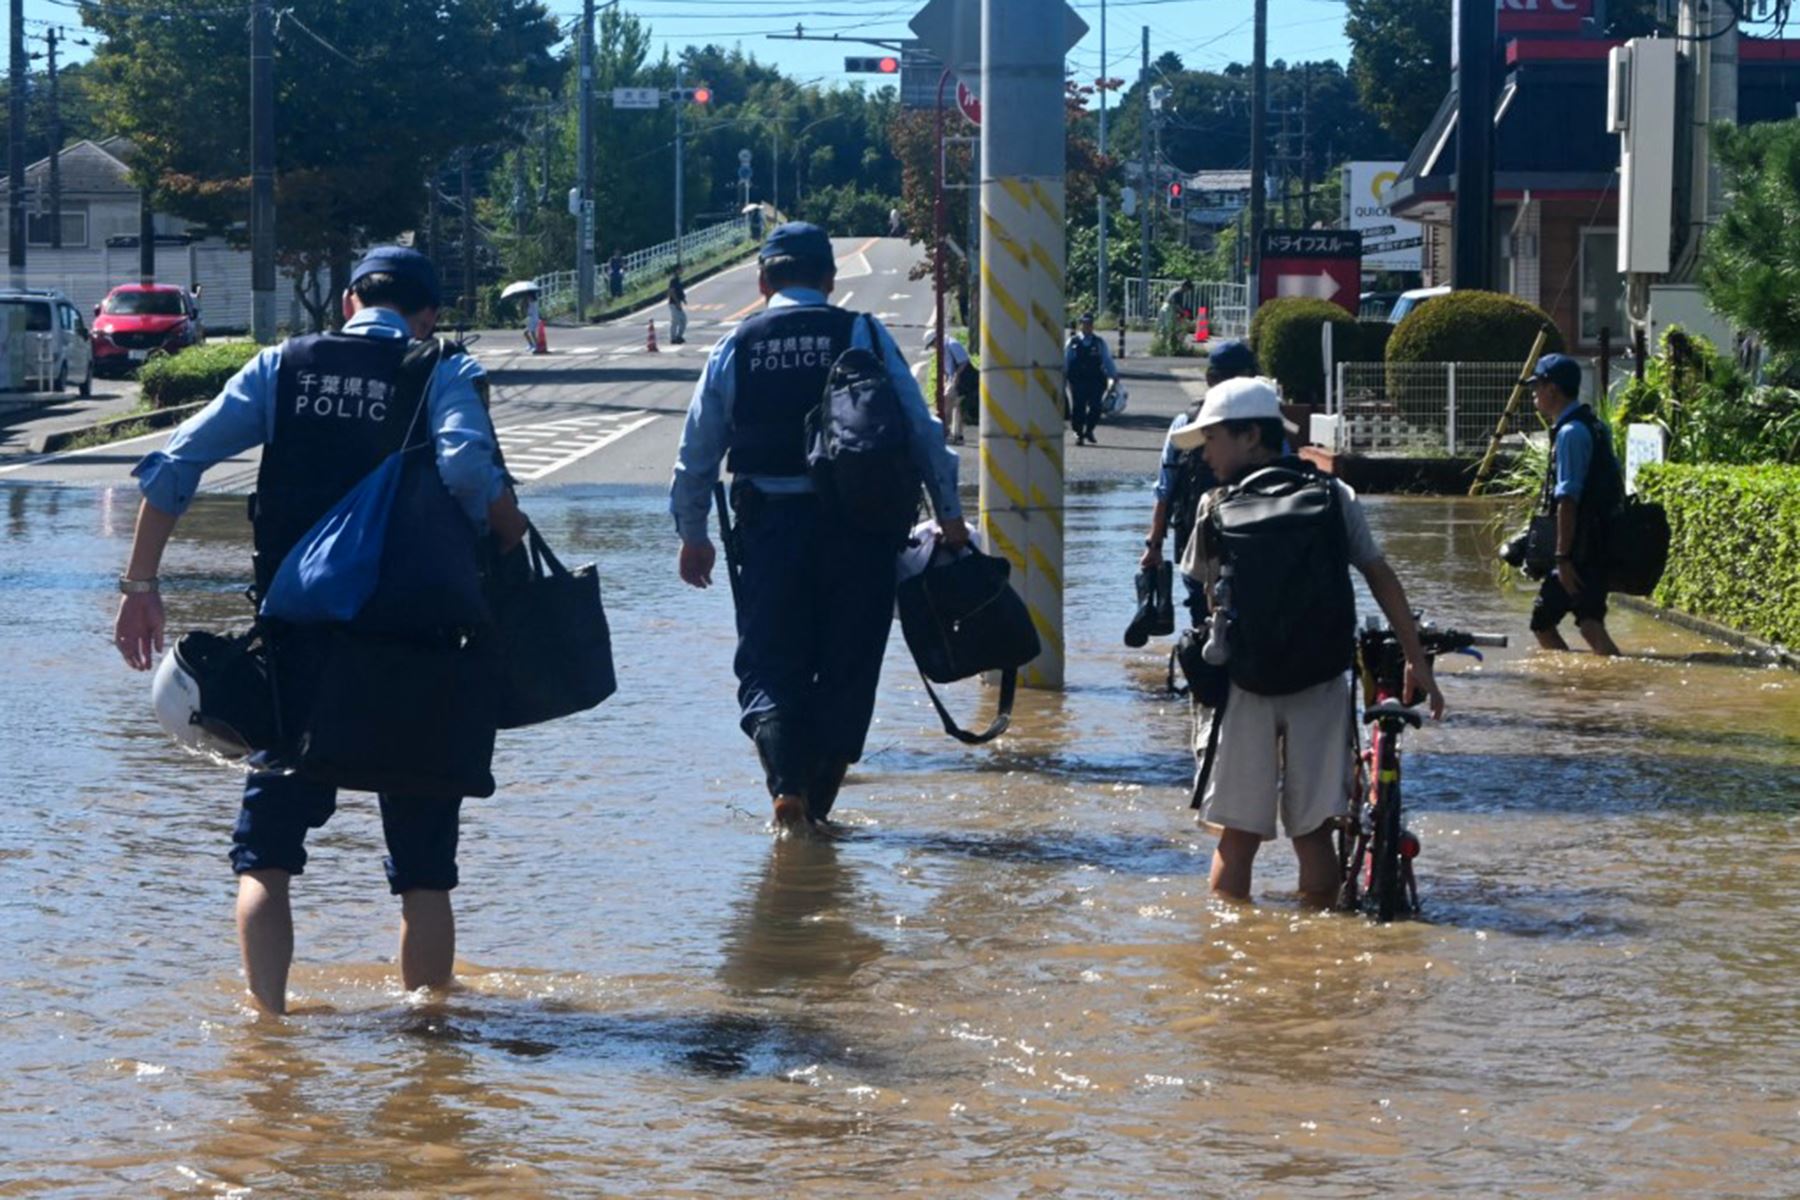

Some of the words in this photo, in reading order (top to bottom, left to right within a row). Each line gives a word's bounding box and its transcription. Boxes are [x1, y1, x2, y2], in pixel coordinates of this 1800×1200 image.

[750, 351, 831, 371] POLICE
[300, 373, 394, 400] 千葉県警
[296, 395, 386, 421] POLIC
